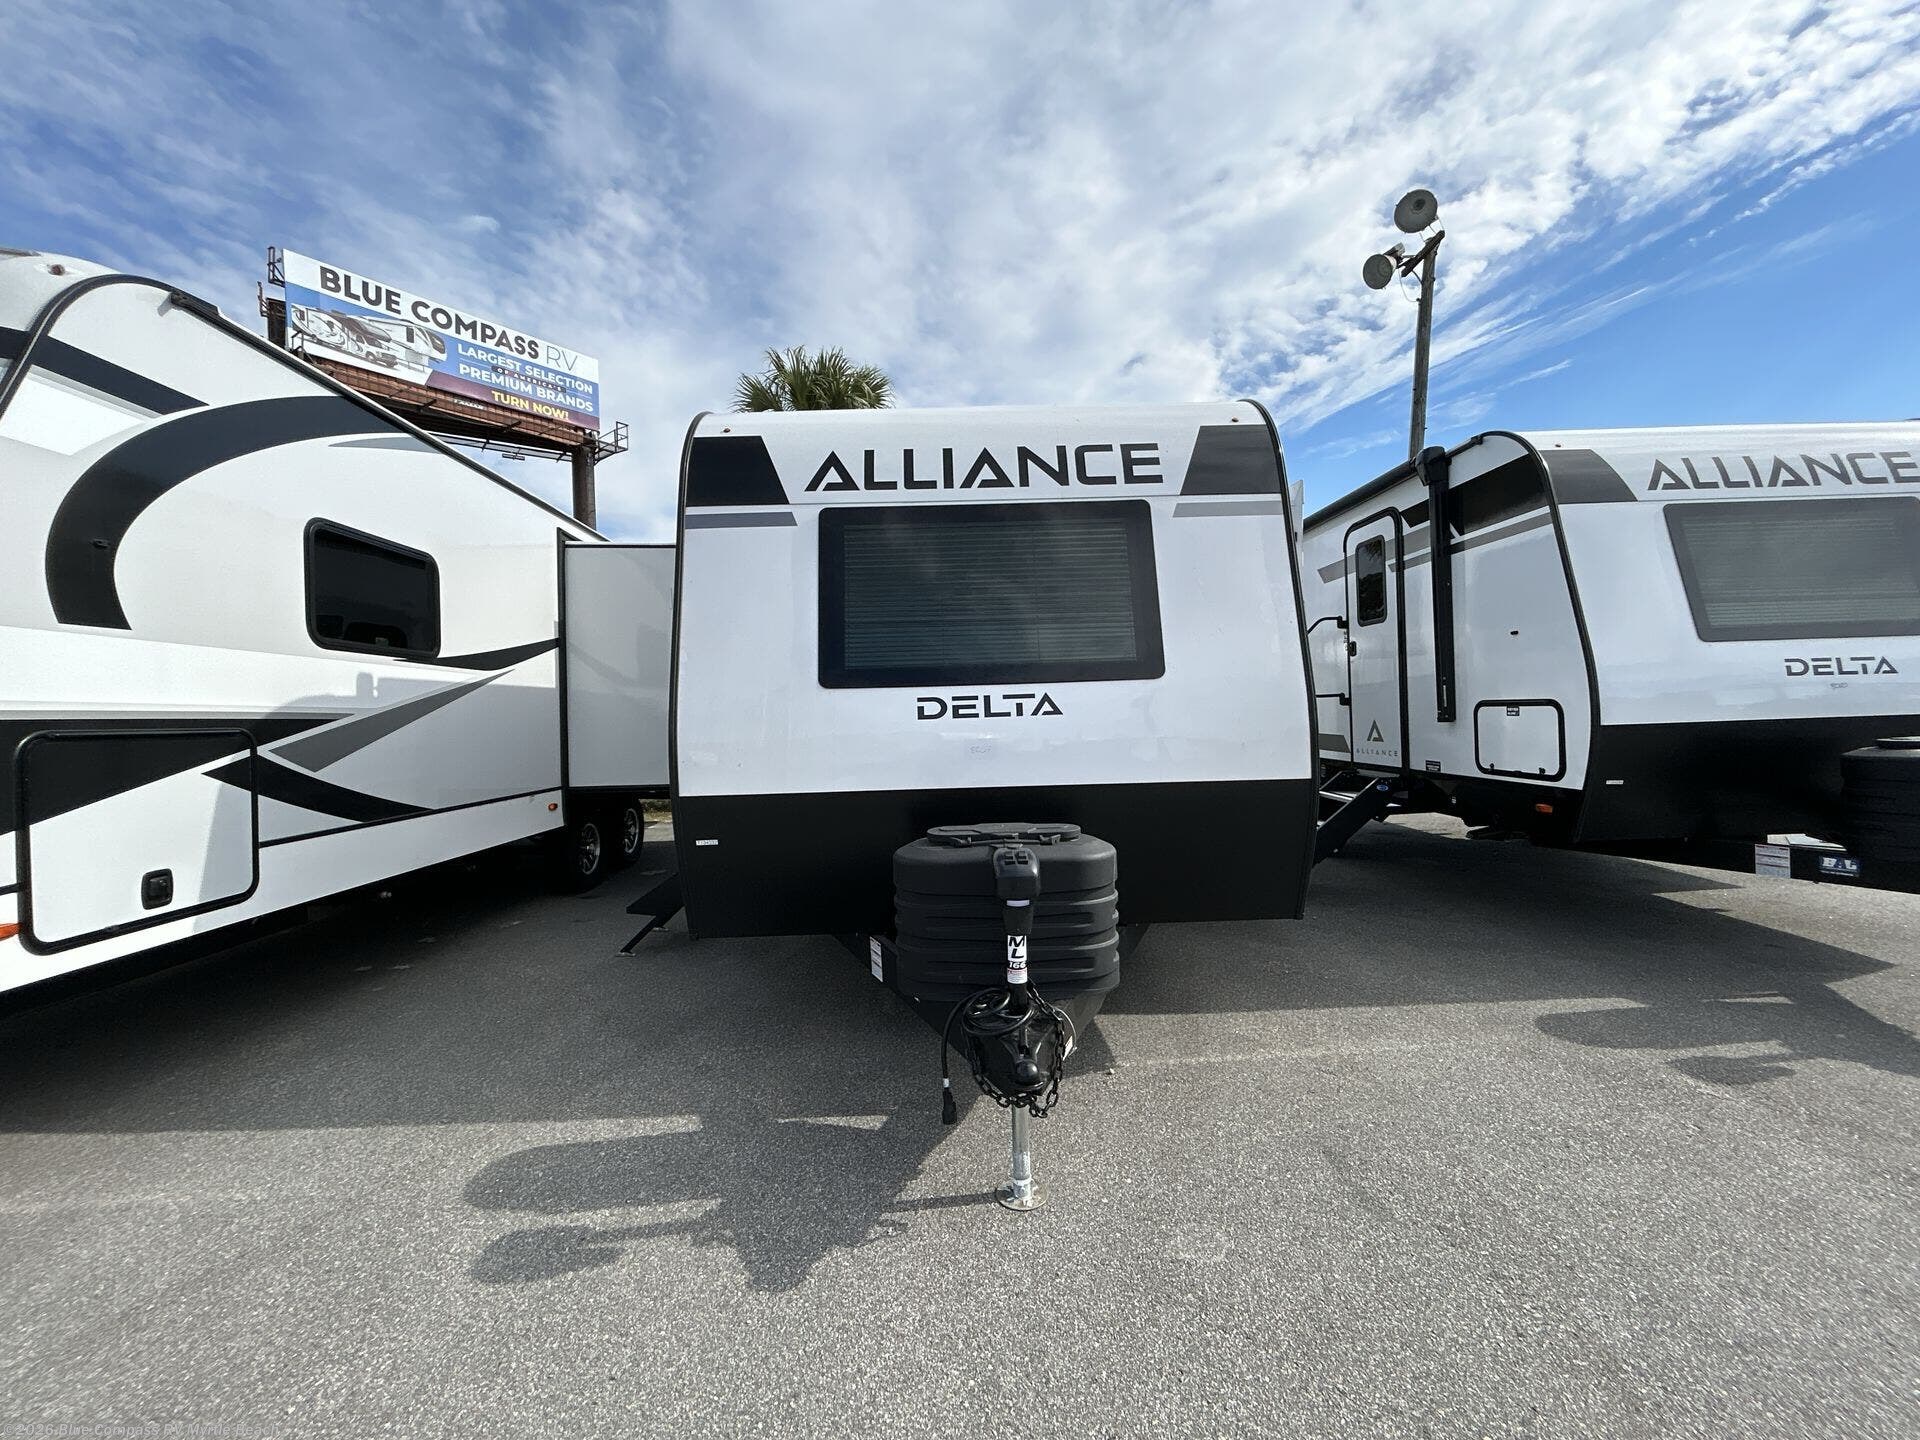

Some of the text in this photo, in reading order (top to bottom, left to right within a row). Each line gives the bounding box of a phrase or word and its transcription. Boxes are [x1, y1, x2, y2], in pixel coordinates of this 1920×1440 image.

[320, 265, 578, 371] BLUE COMPASS RV
[457, 343, 593, 394] LARGEST SELECTION
[458, 363, 594, 412] PREMIUM BRANDS
[492, 390, 530, 410] TURN
[533, 402, 570, 421] NOW!
[804, 442, 1164, 492] ALLIANCE
[1647, 451, 1920, 491] ALLIANCE
[1784, 656, 1899, 677] DELTA
[916, 692, 1063, 720] DELTA
[1356, 747, 1398, 757] ALLIANCE
